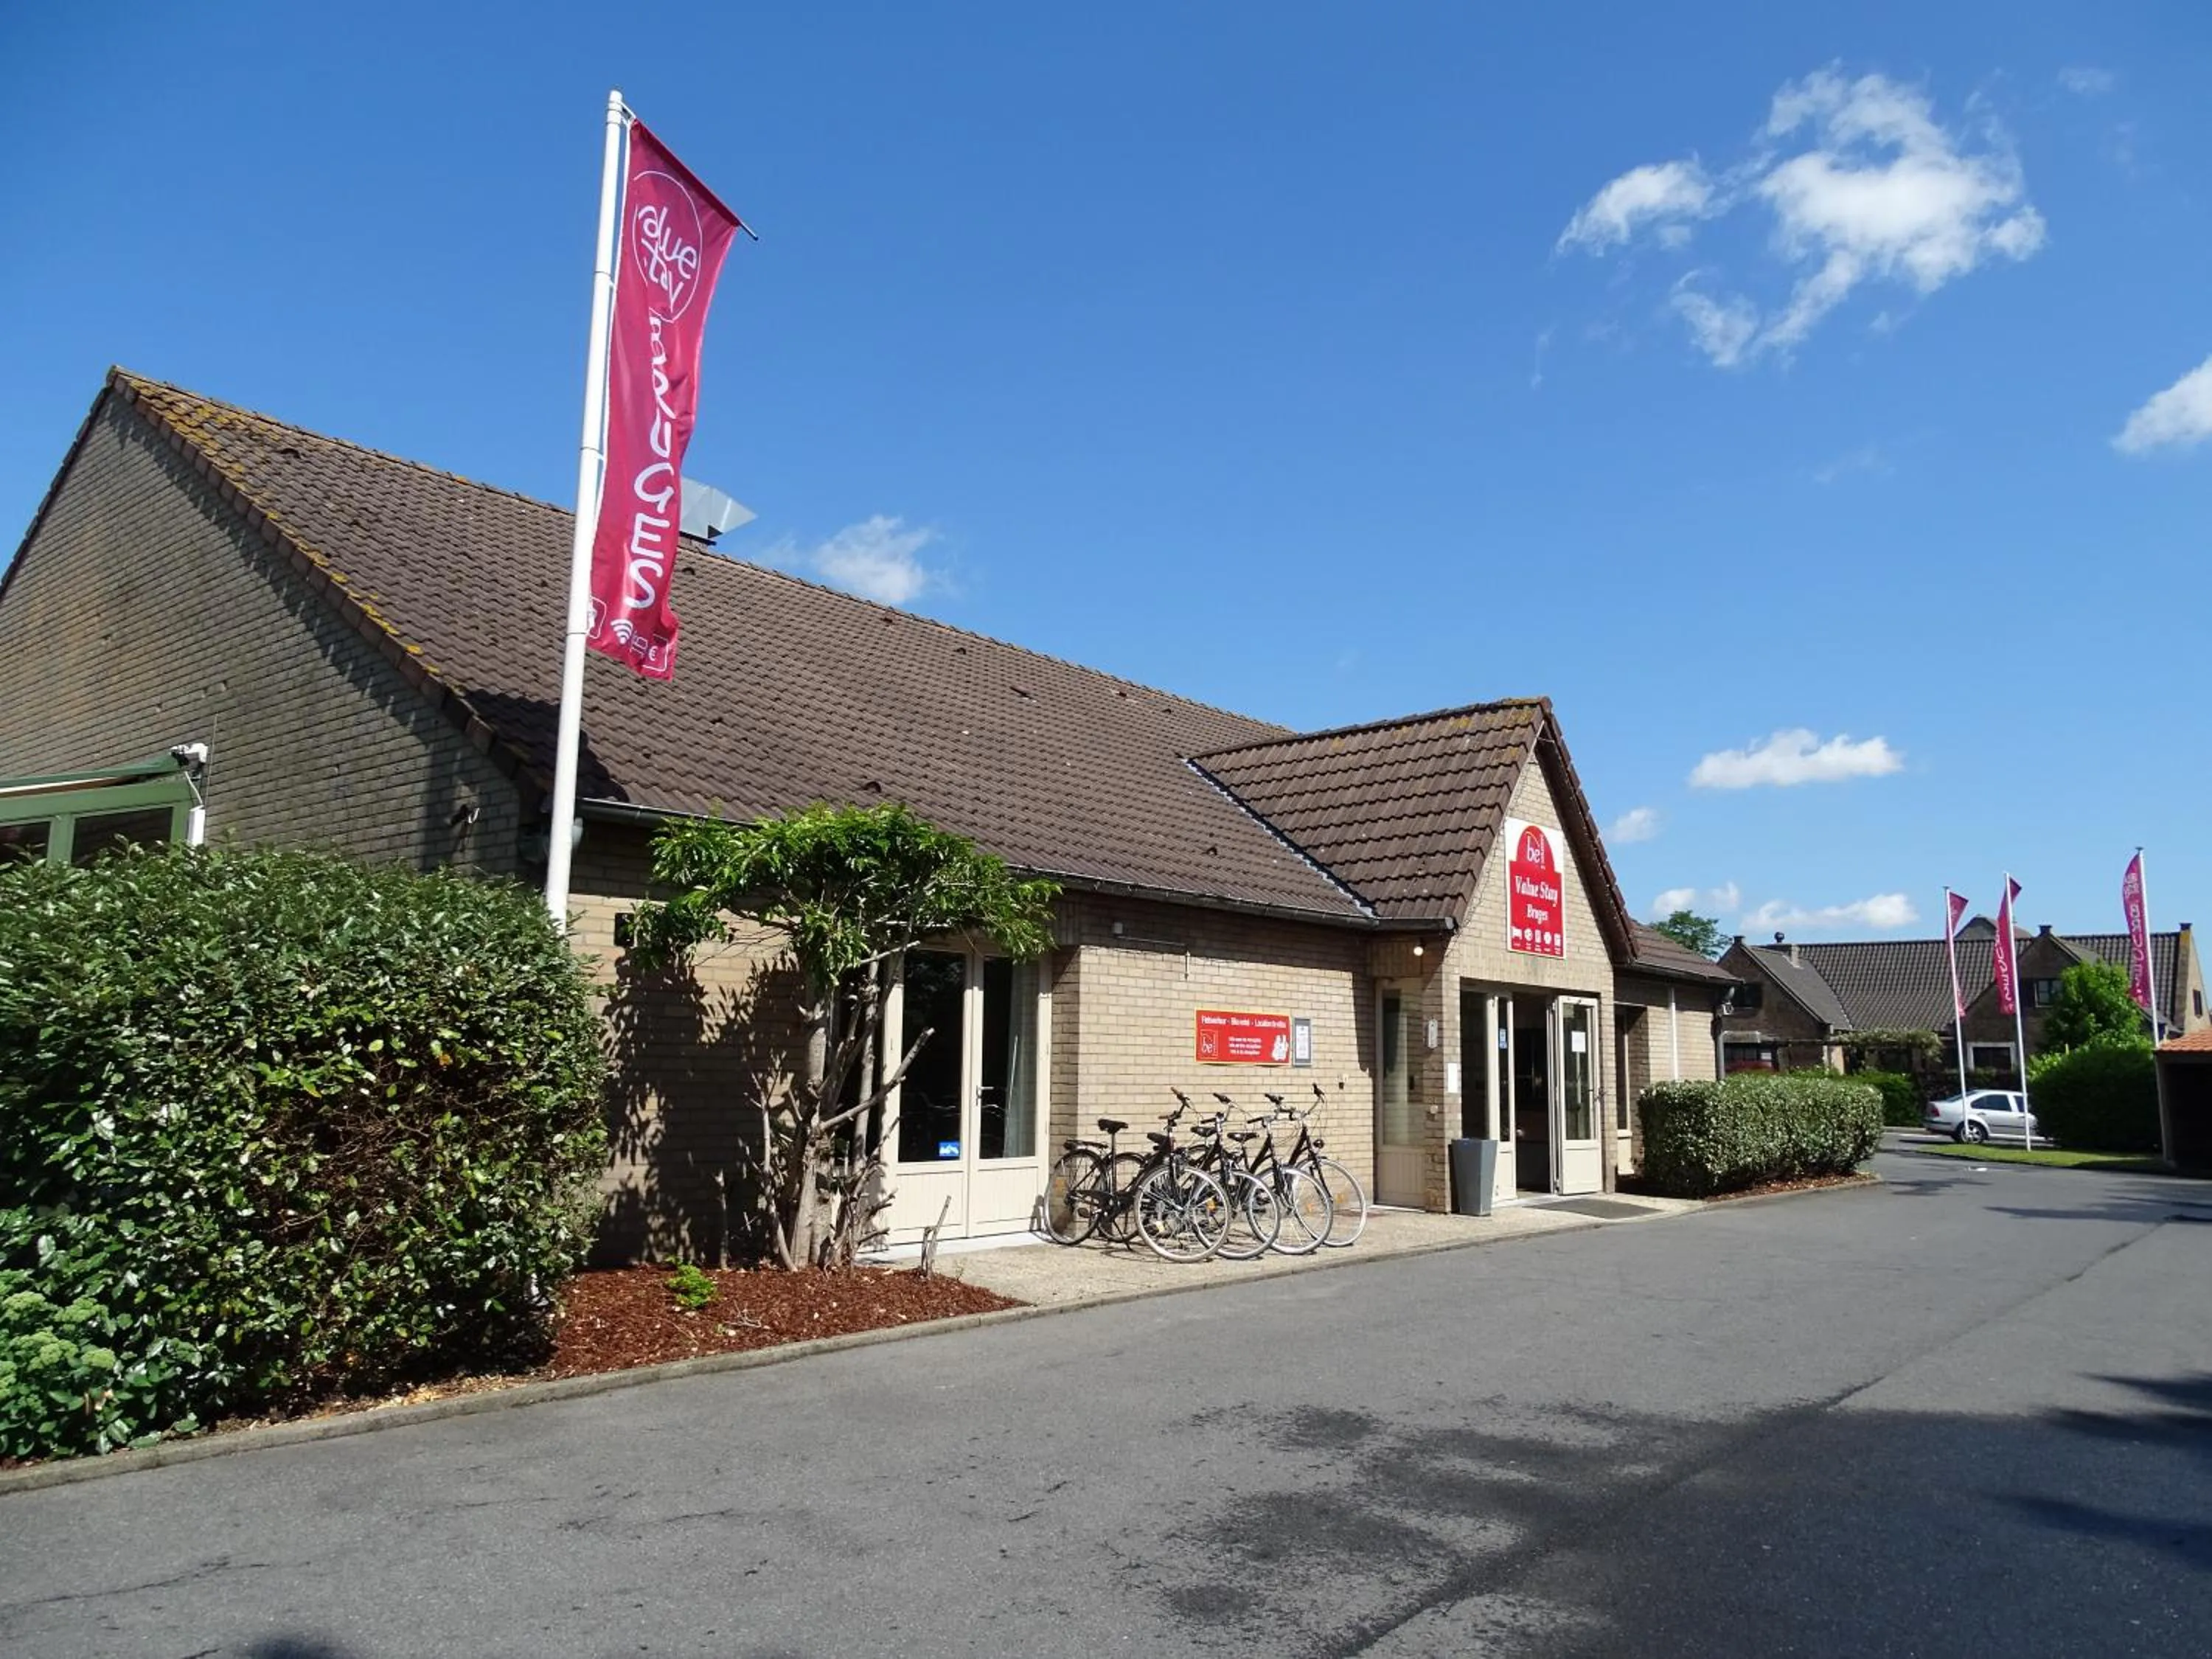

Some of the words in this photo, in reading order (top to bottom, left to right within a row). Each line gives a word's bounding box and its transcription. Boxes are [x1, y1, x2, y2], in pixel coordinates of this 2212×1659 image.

[638, 206, 698, 280] alue
[1514, 875, 1539, 897] Value
[1540, 881, 1558, 908] Stay
[1526, 903, 1548, 925] Bruges
